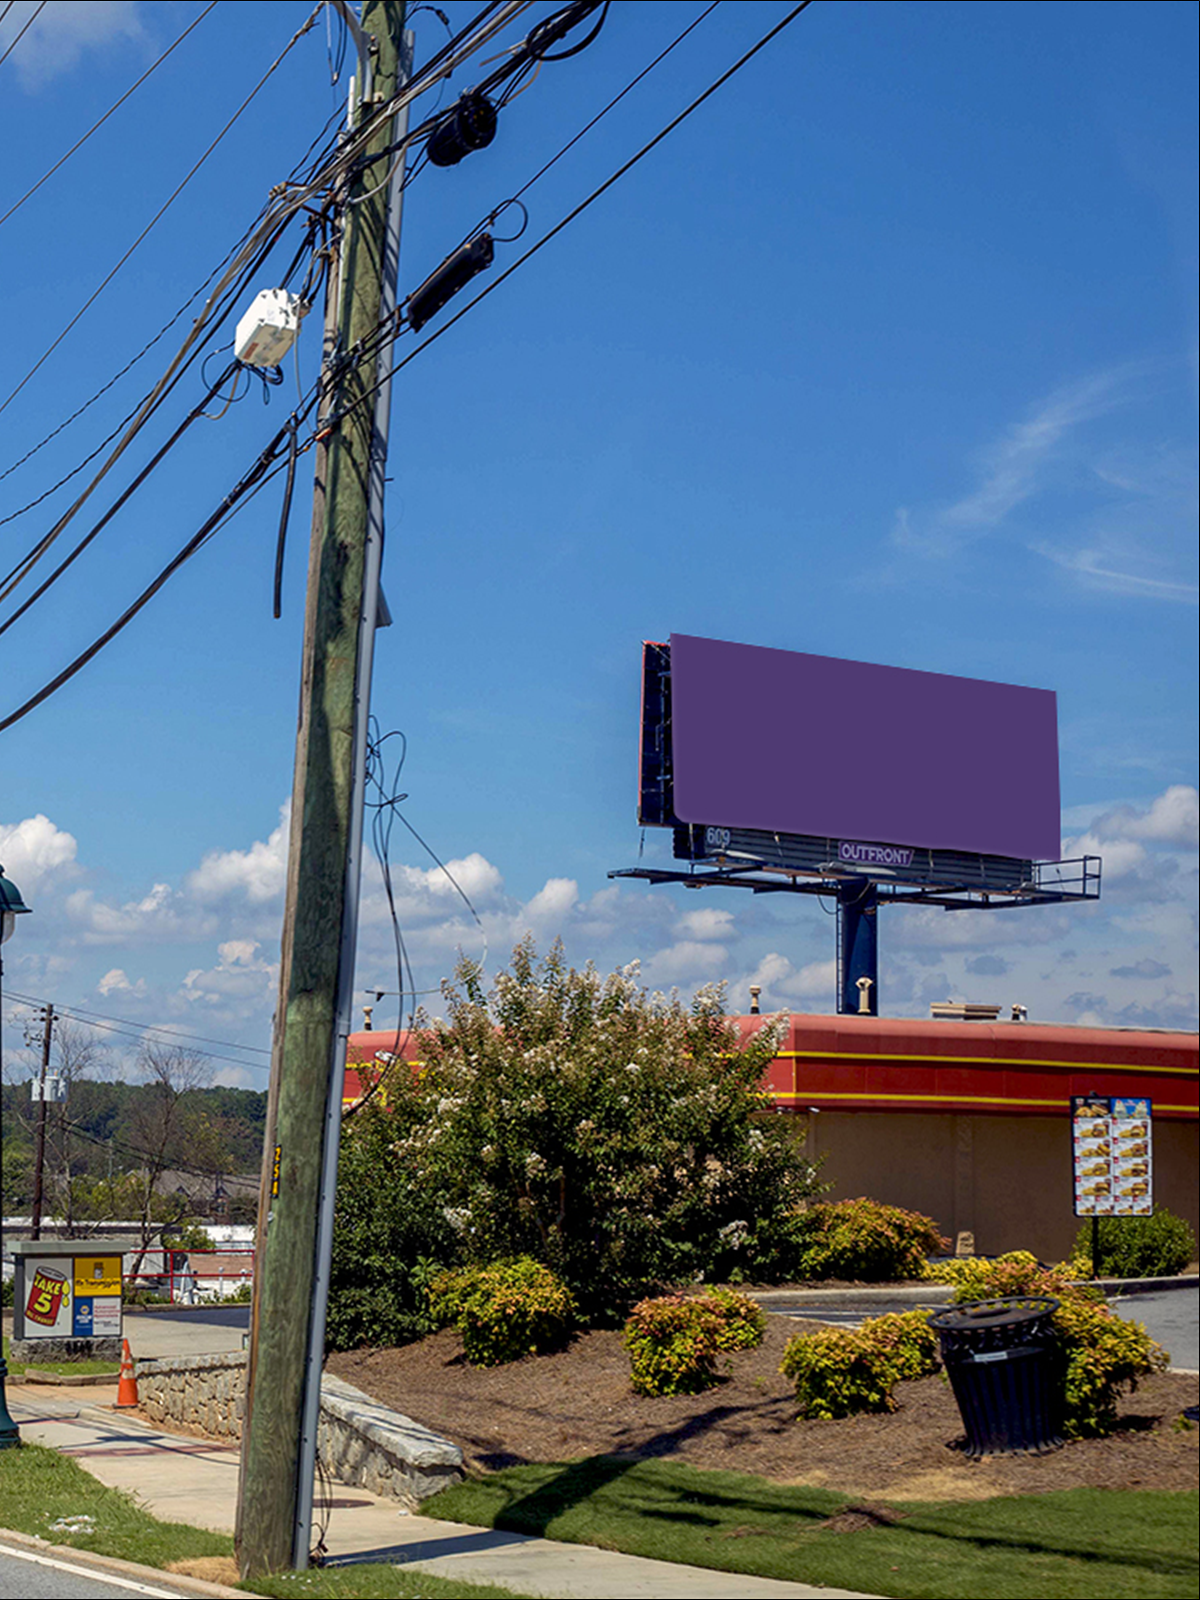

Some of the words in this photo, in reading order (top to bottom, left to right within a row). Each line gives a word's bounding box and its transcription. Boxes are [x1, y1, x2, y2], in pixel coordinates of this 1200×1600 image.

[707, 826, 730, 846] 609
[841, 843, 910, 865] OUTFRONT
[34, 1273, 62, 1296] TAKE
[33, 1291, 52, 1314] 5
